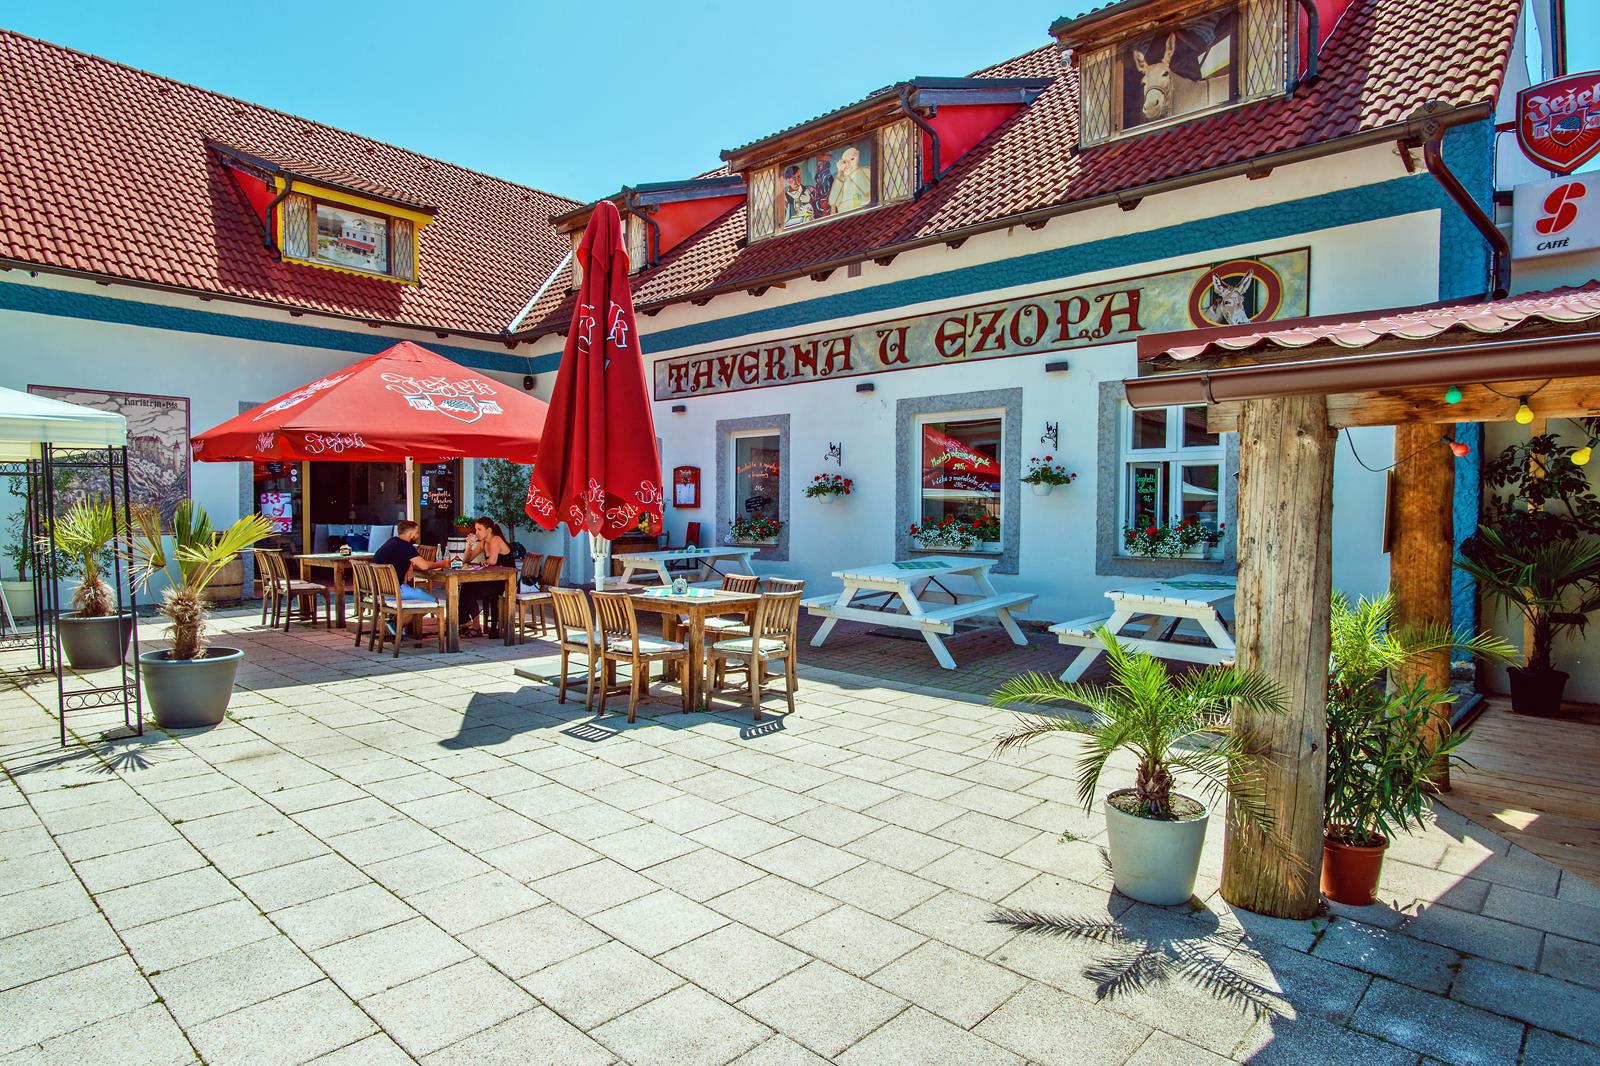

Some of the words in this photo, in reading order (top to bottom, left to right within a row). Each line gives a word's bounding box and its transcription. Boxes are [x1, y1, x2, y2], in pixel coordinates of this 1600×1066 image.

[668, 334, 855, 394] TAVERNA
[876, 325, 912, 366] U
[934, 287, 1147, 358] EZOPA
[304, 432, 366, 454] Ježek
